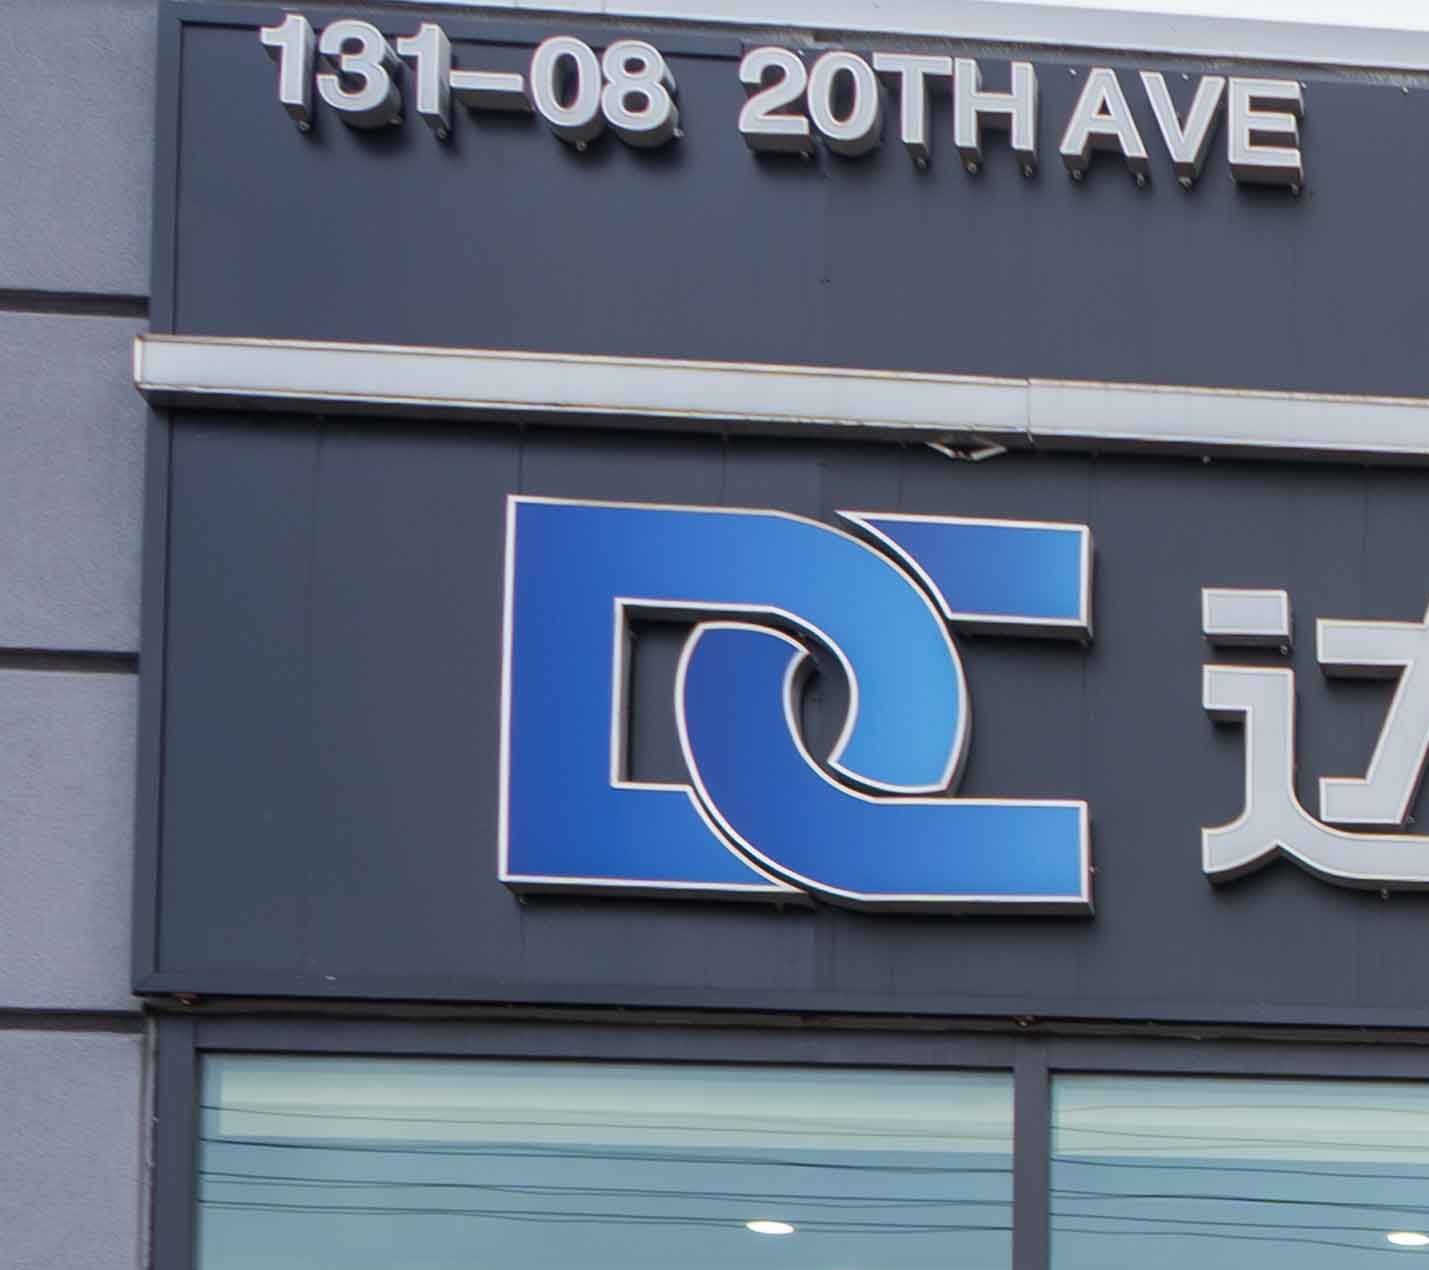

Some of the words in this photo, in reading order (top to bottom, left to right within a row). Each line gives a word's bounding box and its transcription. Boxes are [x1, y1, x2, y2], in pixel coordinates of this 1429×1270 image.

[261, 14, 680, 148] 131-08
[738, 48, 1038, 172] 20TH
[1060, 67, 1306, 190] AVE
[499, 494, 1094, 916] DC
